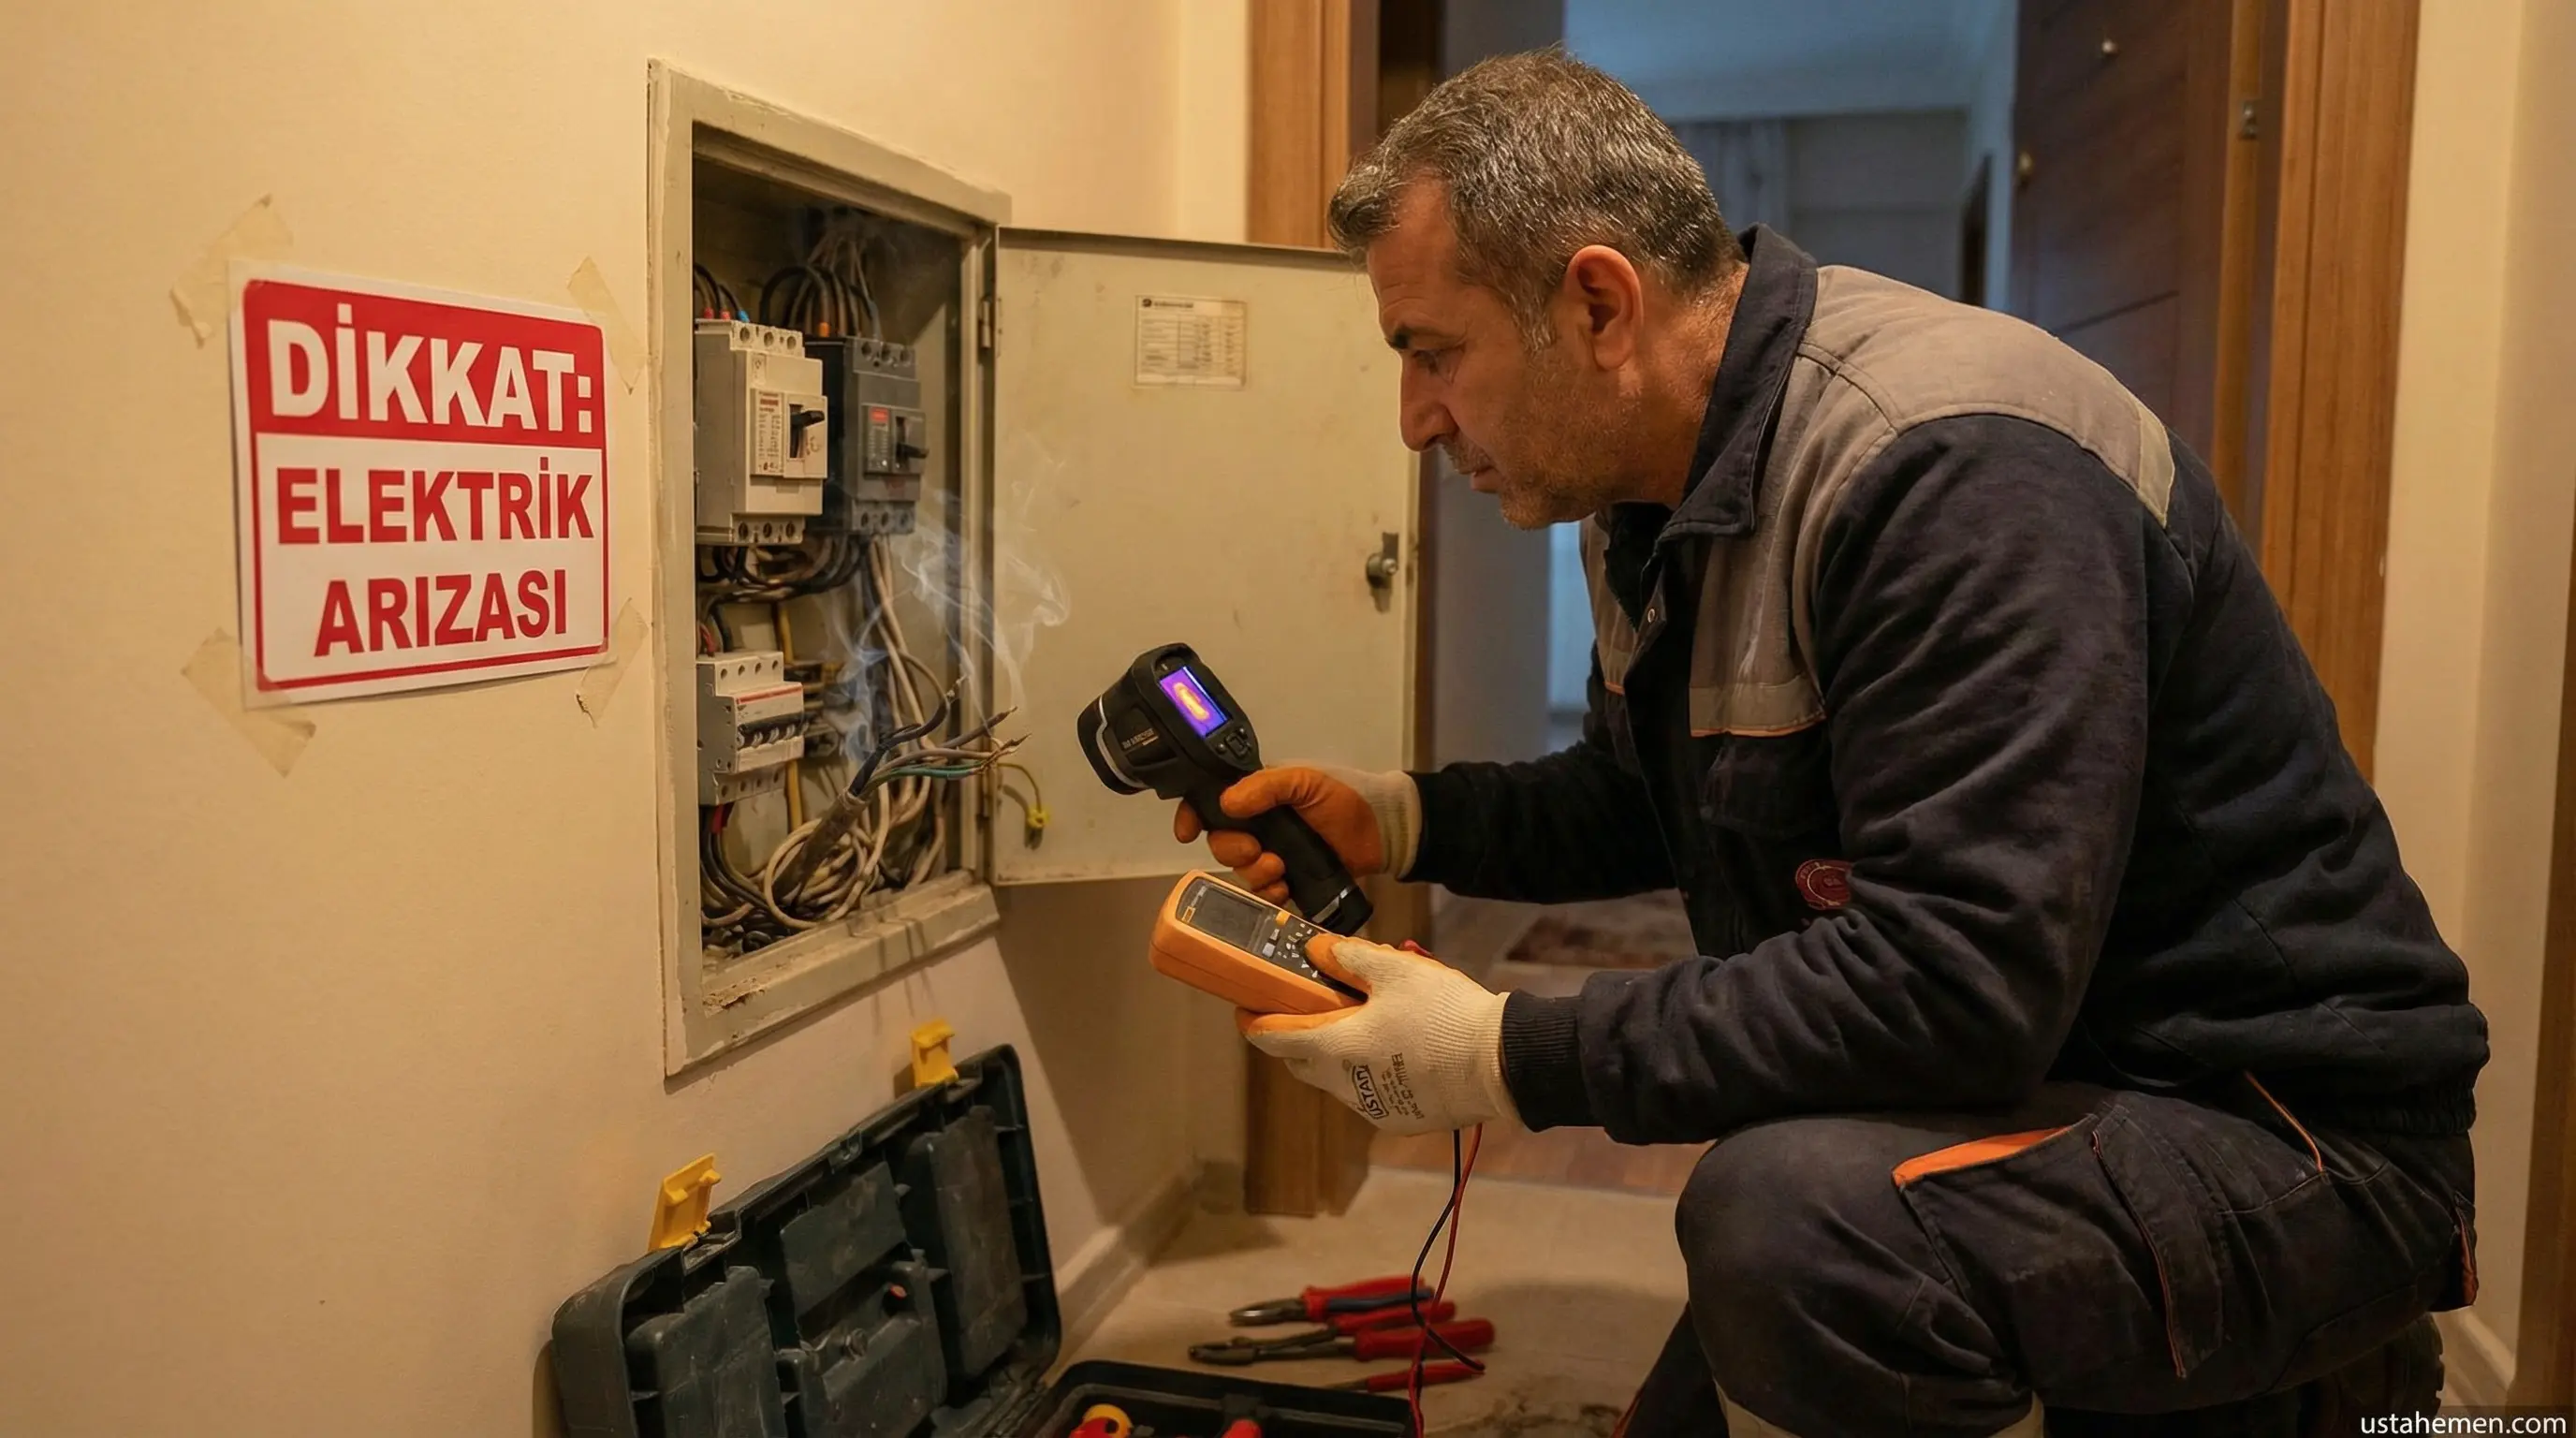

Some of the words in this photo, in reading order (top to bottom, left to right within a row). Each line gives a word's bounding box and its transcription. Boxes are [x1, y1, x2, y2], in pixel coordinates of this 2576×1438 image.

[267, 302, 593, 433] DİKKAT:
[277, 456, 594, 545] ELEKTRİK
[315, 568, 567, 658] ARIZASI
